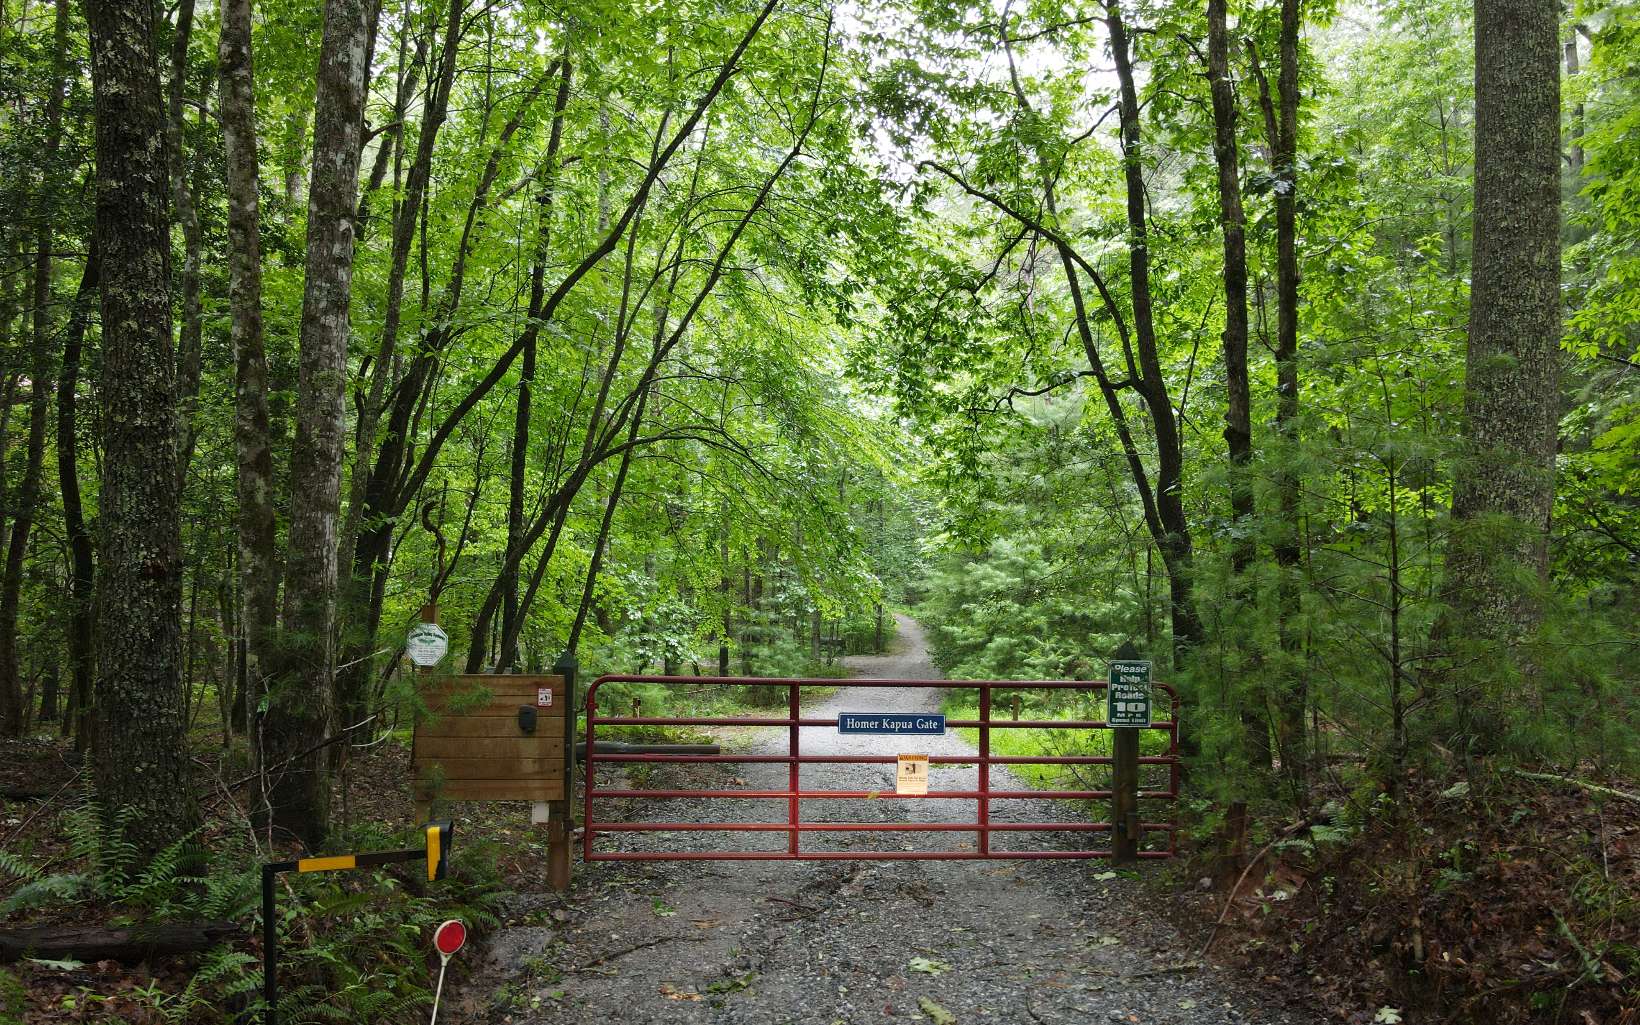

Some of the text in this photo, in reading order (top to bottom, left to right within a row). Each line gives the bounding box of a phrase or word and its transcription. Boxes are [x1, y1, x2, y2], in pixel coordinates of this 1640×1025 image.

[1114, 664, 1147, 673] Please
[1119, 674, 1141, 683] Help
[1115, 691, 1145, 700] Roads
[1112, 702, 1146, 712] 10
[846, 718, 938, 732] Homer Kapua Gate
